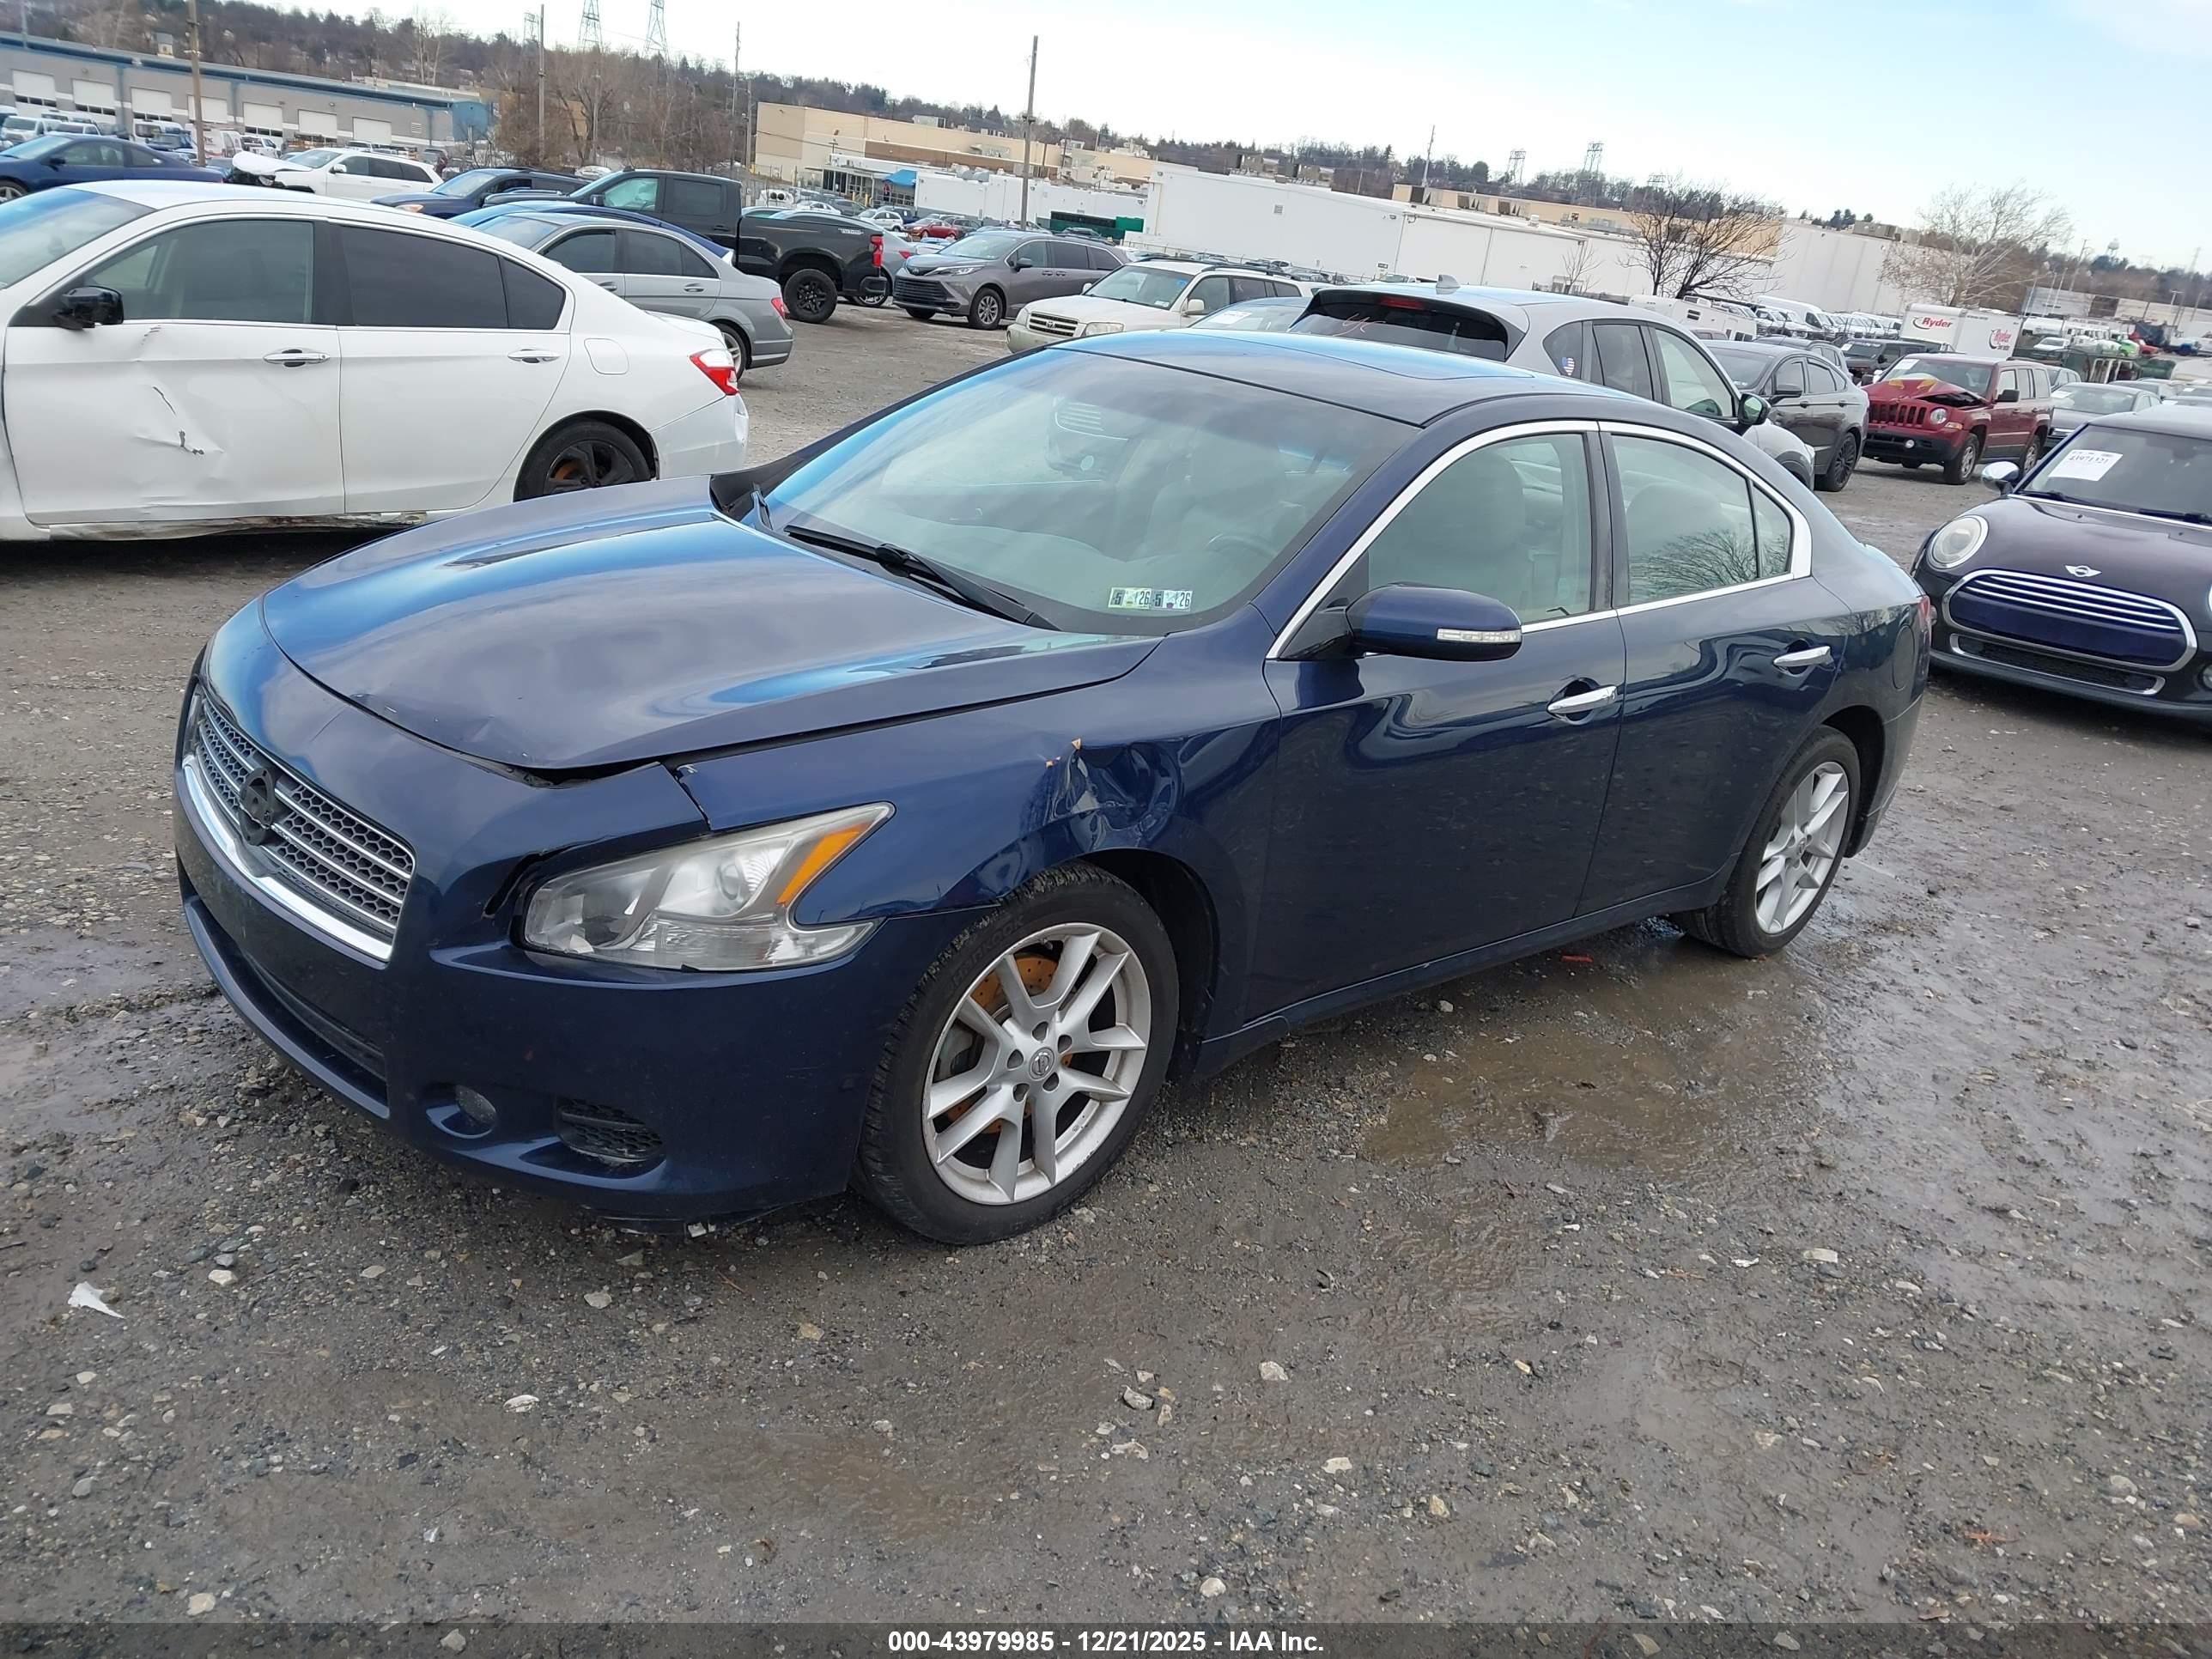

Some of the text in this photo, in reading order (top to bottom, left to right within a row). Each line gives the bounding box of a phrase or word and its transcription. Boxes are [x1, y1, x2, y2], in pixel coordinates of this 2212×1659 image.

[1922, 317, 1953, 328] Ryder
[1139, 591, 1150, 605] 26
[1179, 592, 1190, 607] 26
